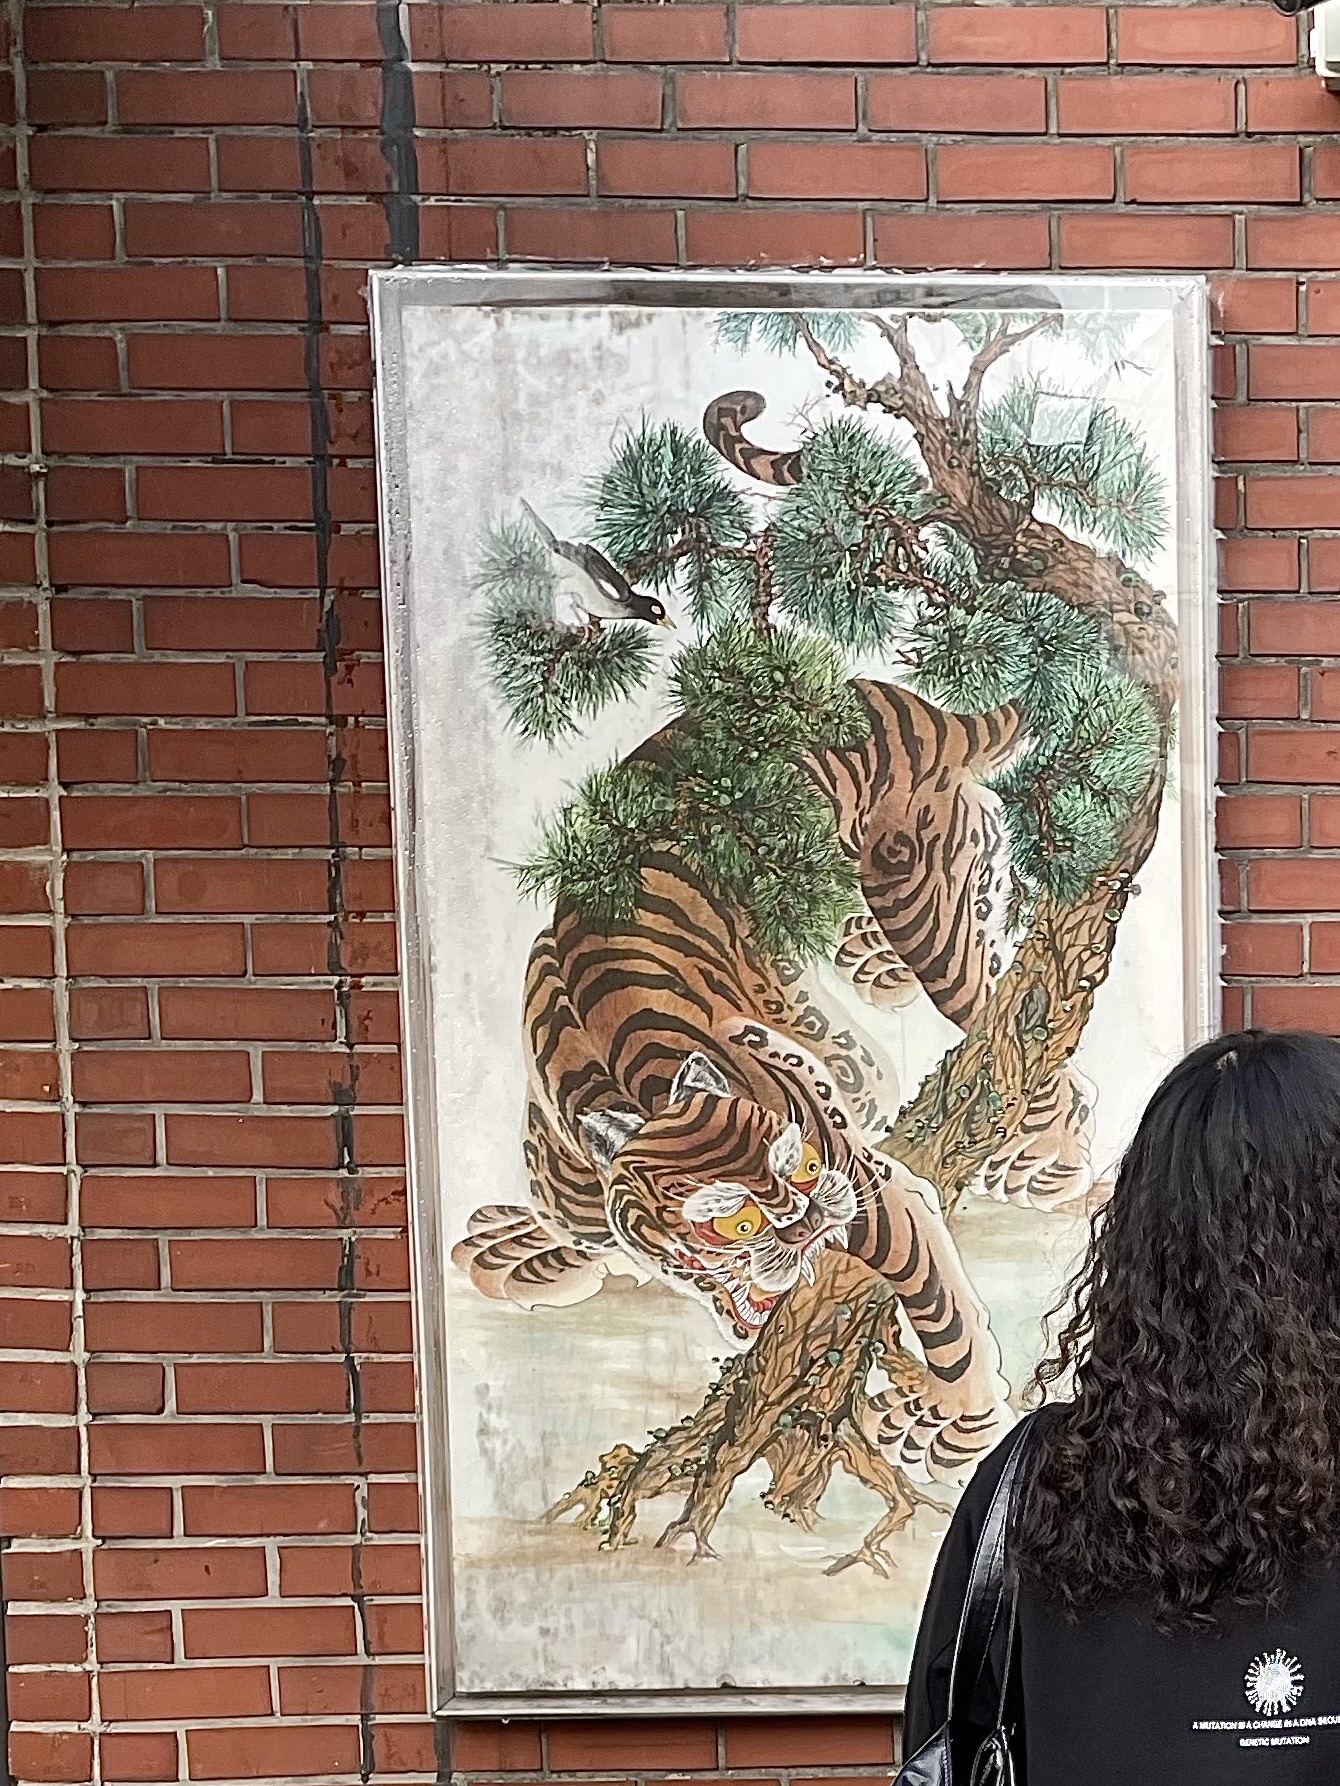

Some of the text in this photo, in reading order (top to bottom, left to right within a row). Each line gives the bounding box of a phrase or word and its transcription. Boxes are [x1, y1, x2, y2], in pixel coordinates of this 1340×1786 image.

[1199, 1721, 1238, 1730] MUTATION
[1252, 1719, 1283, 1729] CHANGE
[1300, 1718, 1317, 1727] DNA
[1239, 1735, 1310, 1747] GENETIC MUTATION
